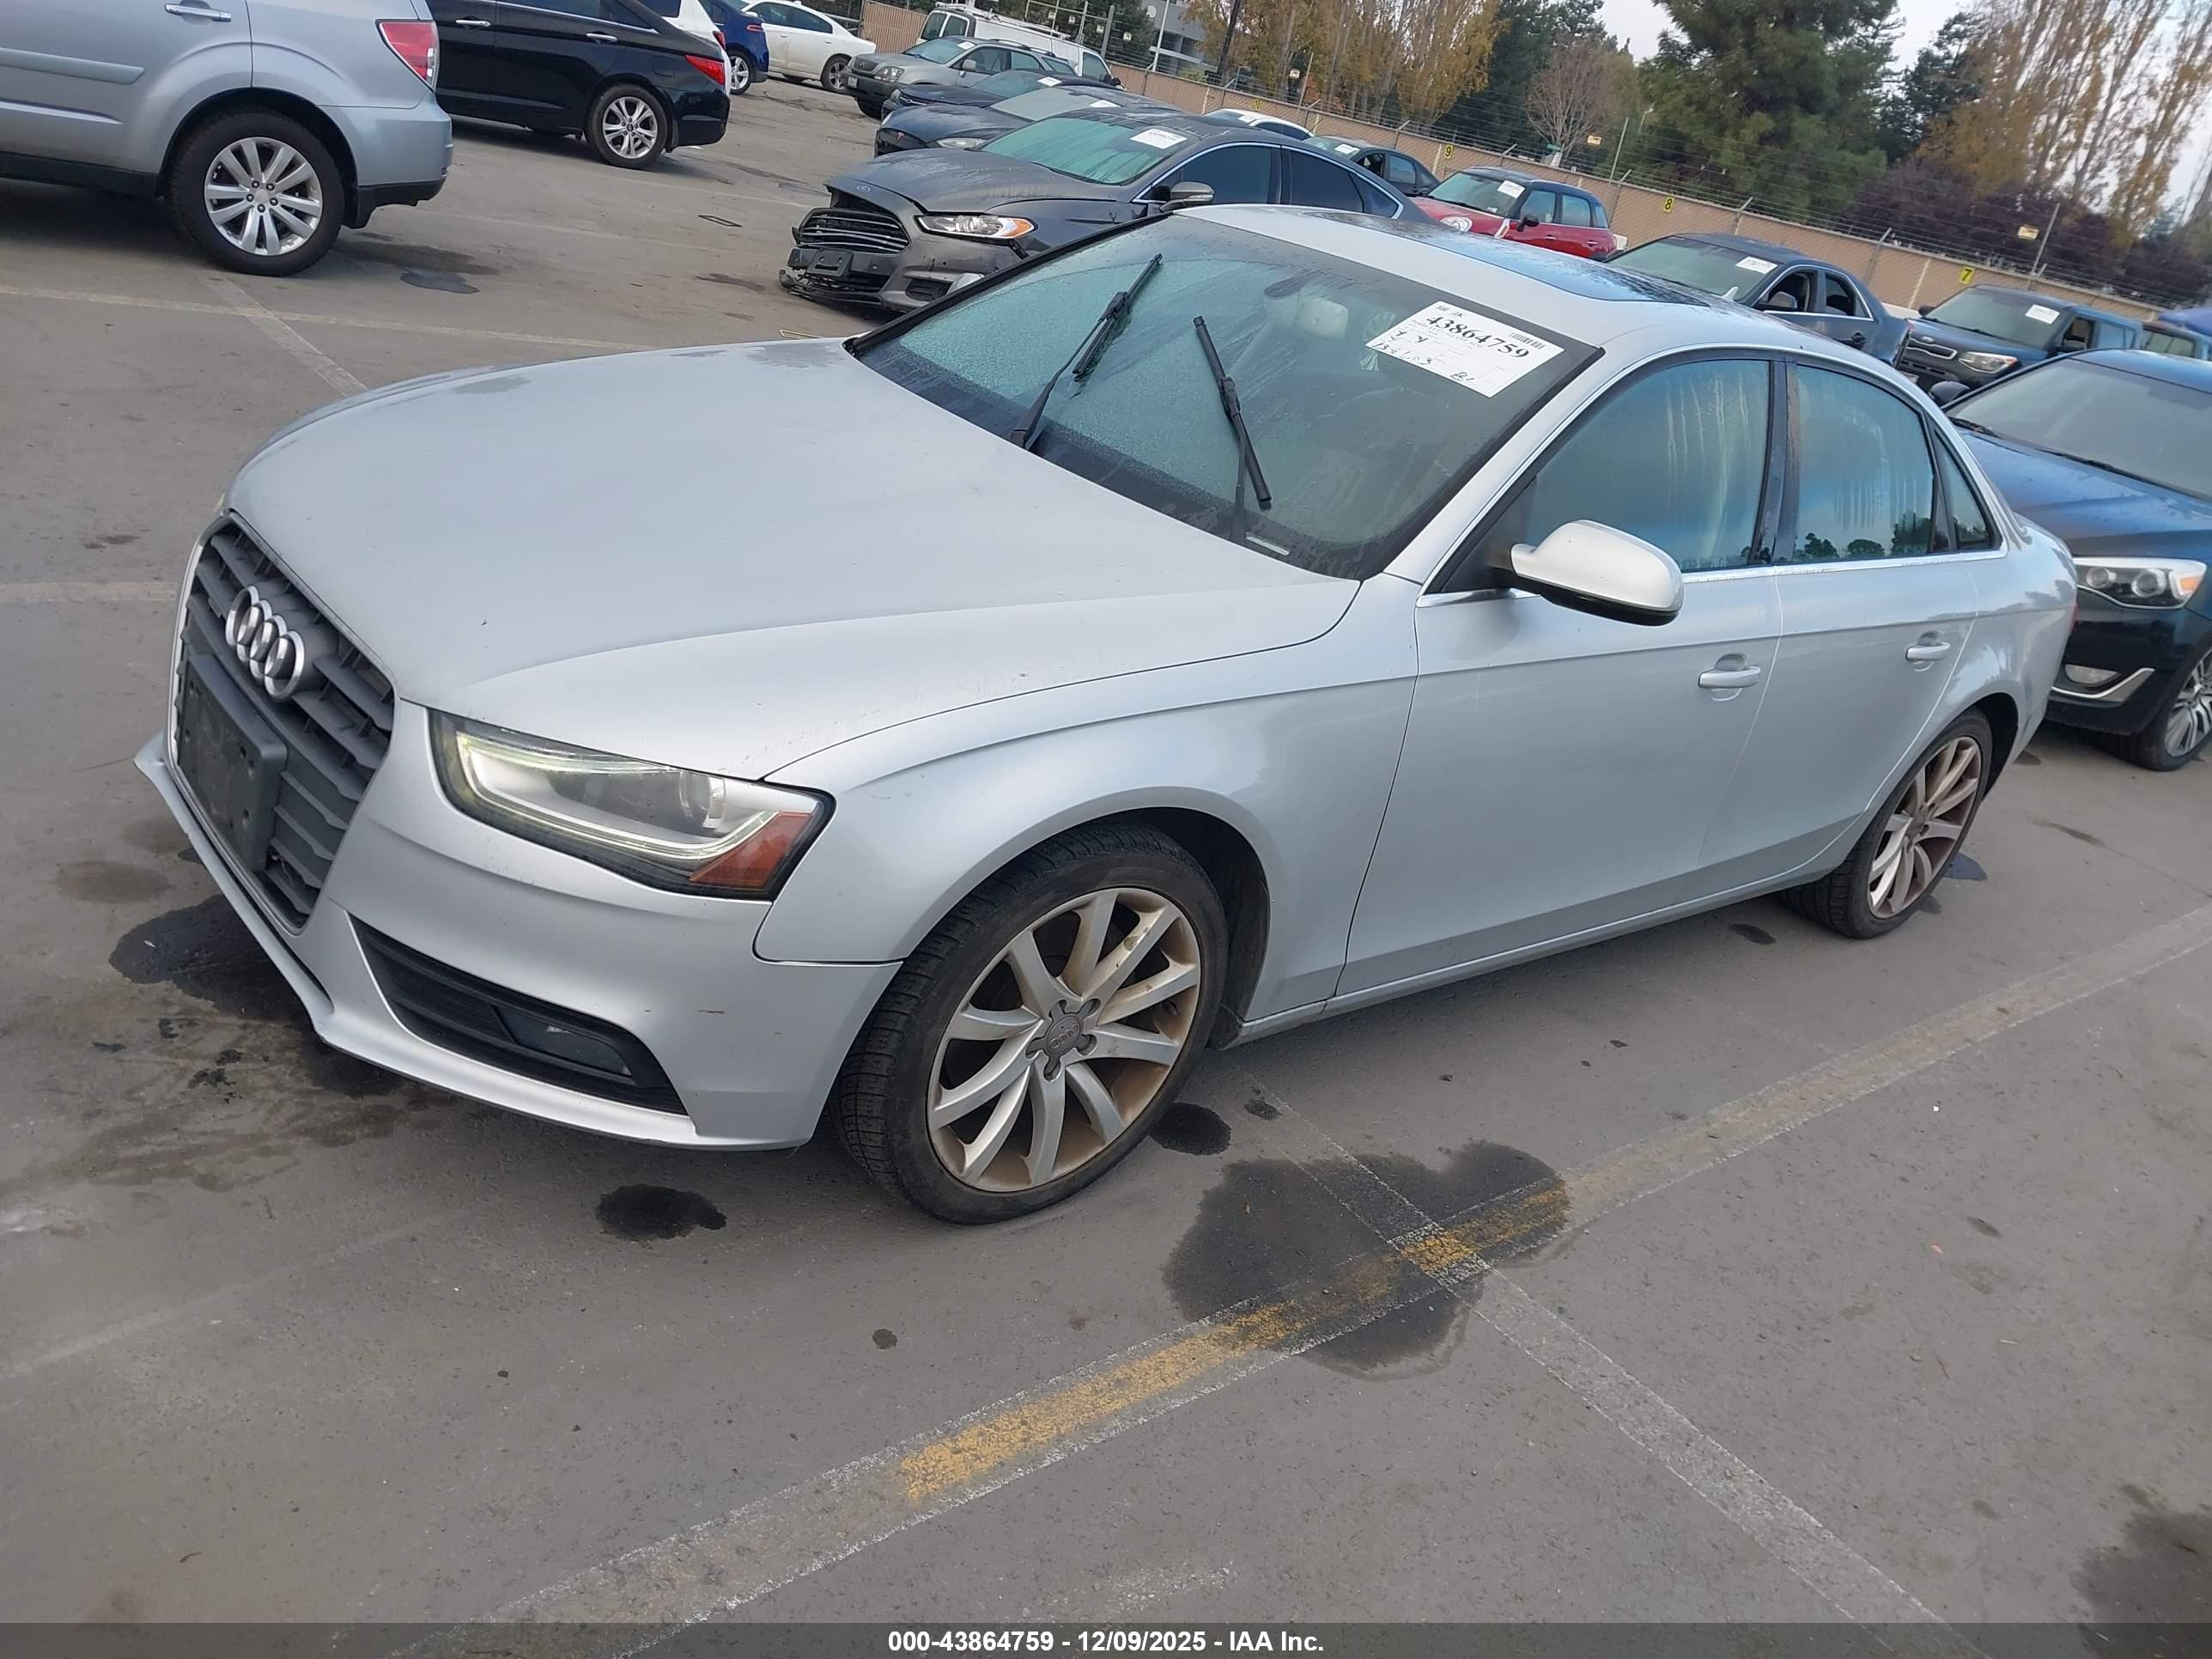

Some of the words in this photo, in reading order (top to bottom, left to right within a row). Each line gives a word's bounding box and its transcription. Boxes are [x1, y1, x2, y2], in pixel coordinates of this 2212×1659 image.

[1445, 145, 1452, 157] 9
[1664, 198, 1673, 210] 8
[1961, 268, 1972, 282] 7
[1425, 316, 1529, 358] 43864759
